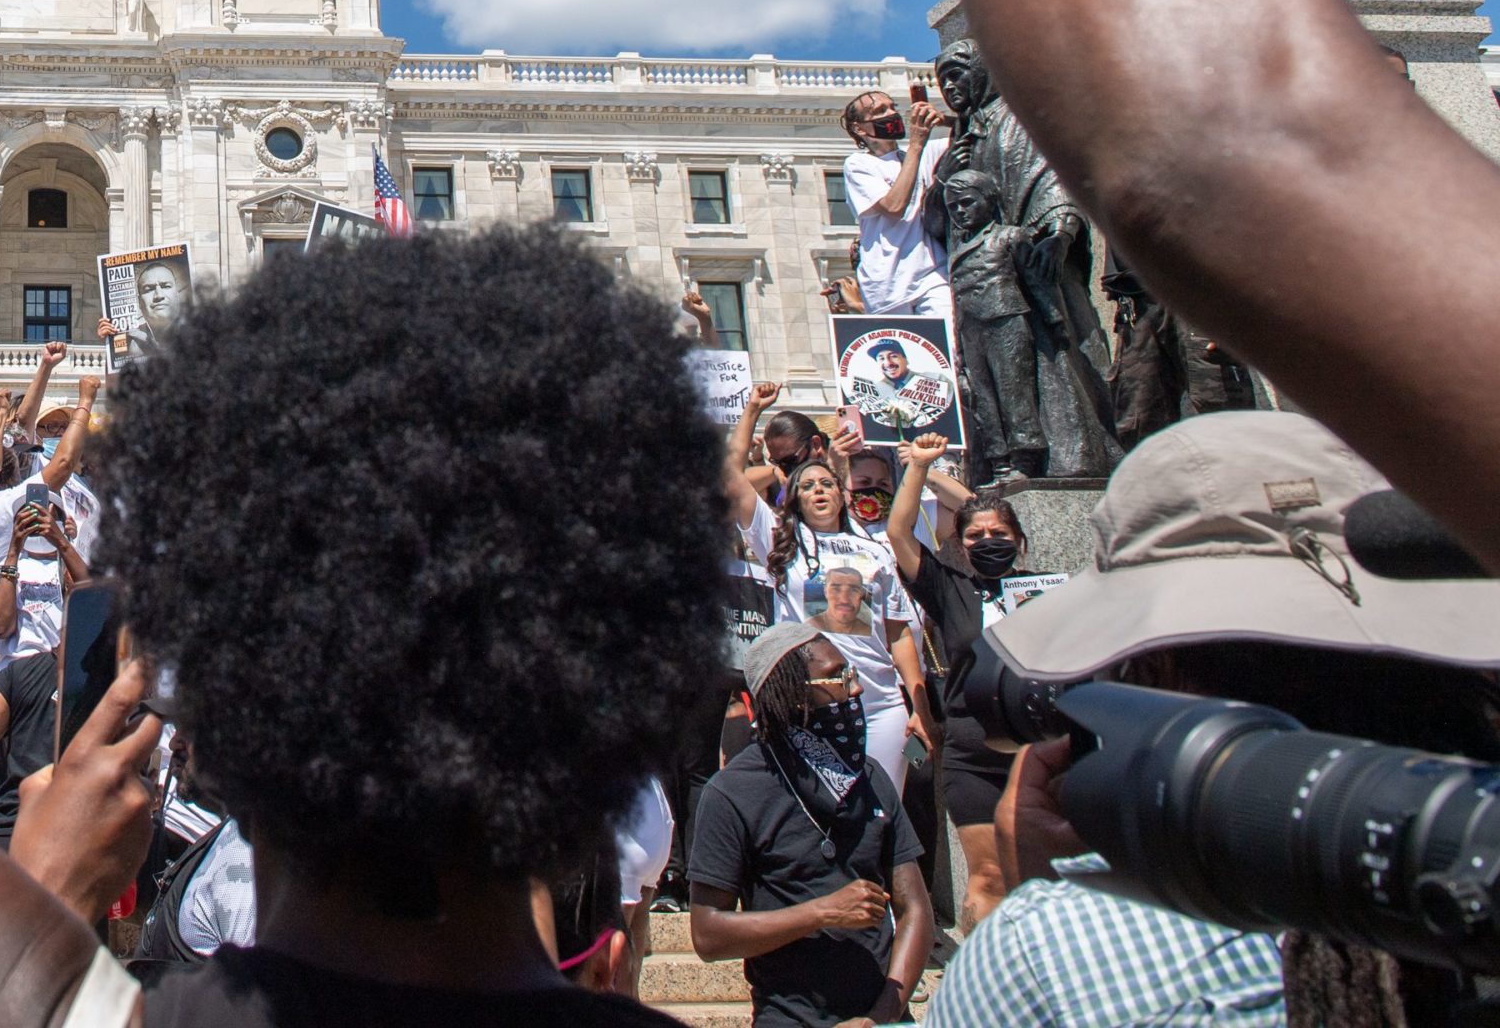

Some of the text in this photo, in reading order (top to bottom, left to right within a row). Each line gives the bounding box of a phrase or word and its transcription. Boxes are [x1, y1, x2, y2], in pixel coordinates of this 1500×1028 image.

[147, 249, 159, 260] MY
[109, 266, 133, 282] PAUL
[112, 306, 126, 316] JULY
[112, 314, 140, 332] 2015
[898, 331, 921, 344] POLICE
[853, 380, 879, 397] 2016
[708, 393, 740, 409] mmett
[1003, 579, 1038, 589] Anthony
